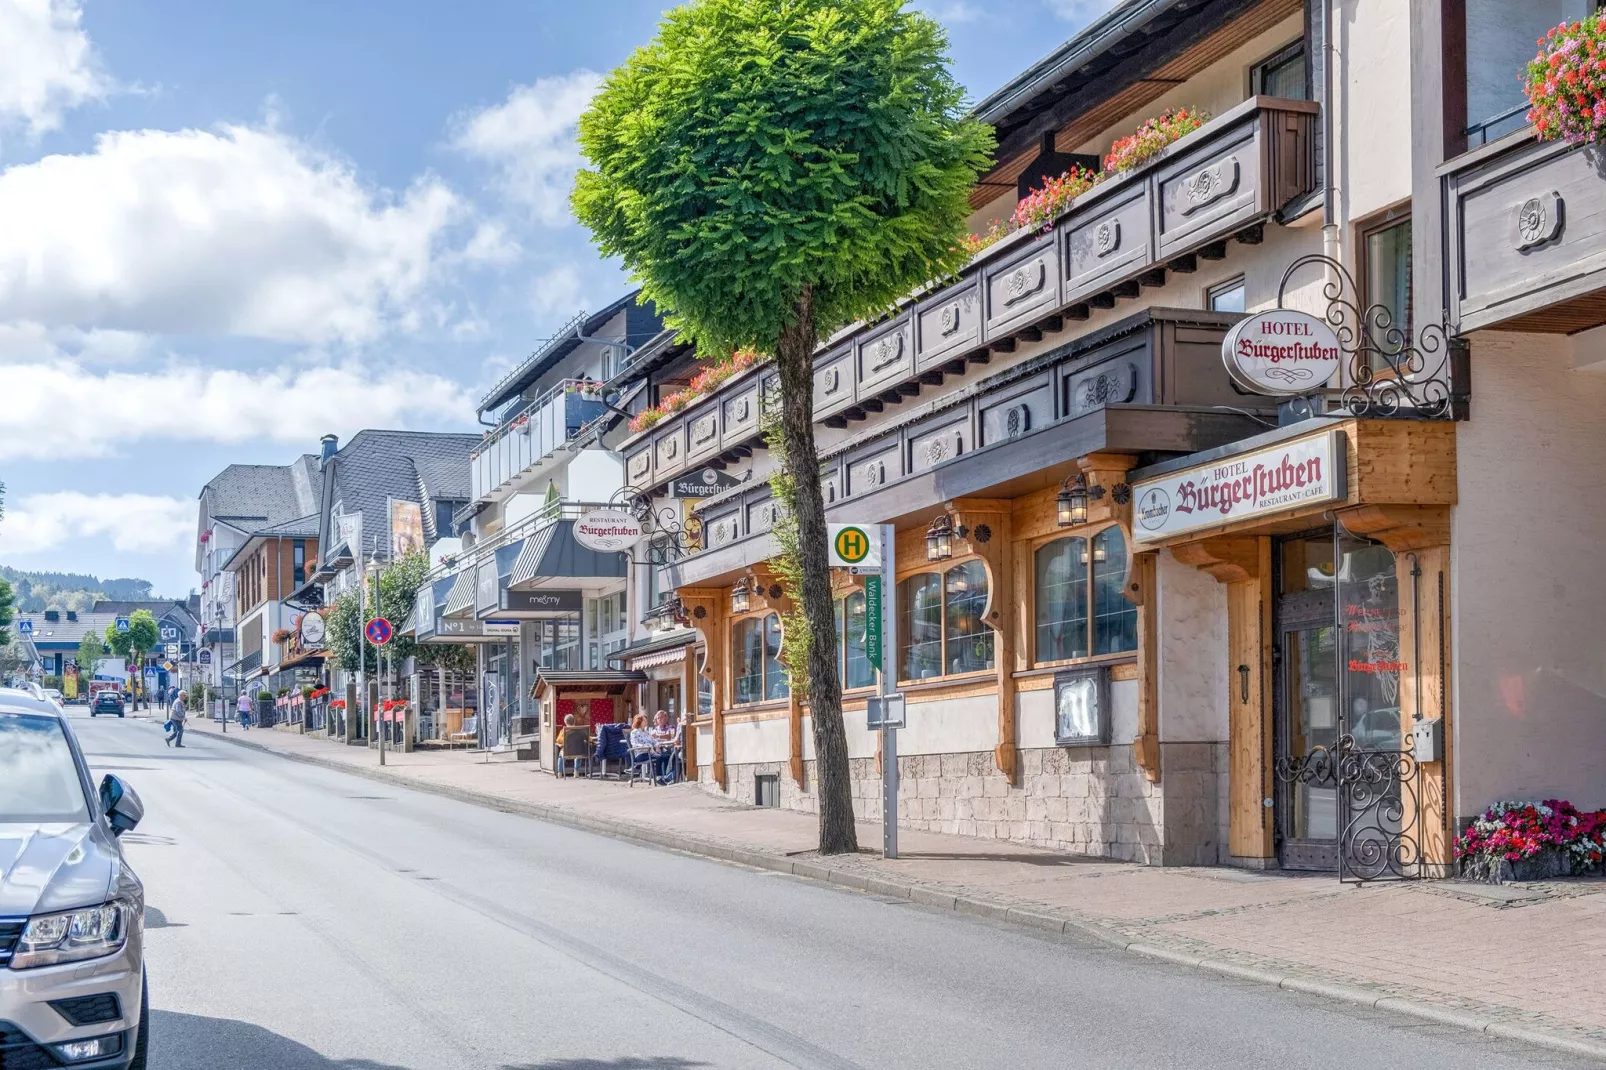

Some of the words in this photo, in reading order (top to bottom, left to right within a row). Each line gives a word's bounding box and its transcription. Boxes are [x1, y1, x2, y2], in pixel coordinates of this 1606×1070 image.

[1261, 321, 1313, 336] HOTEL
[1214, 462, 1248, 481] HOTEL
[1259, 491, 1301, 508] RESTAURANT
[1305, 485, 1323, 497] CAFÉ
[843, 534, 861, 556] H
[529, 594, 561, 606] me&my
[868, 581, 878, 631] Waldecker
[868, 634, 878, 659] Bank
